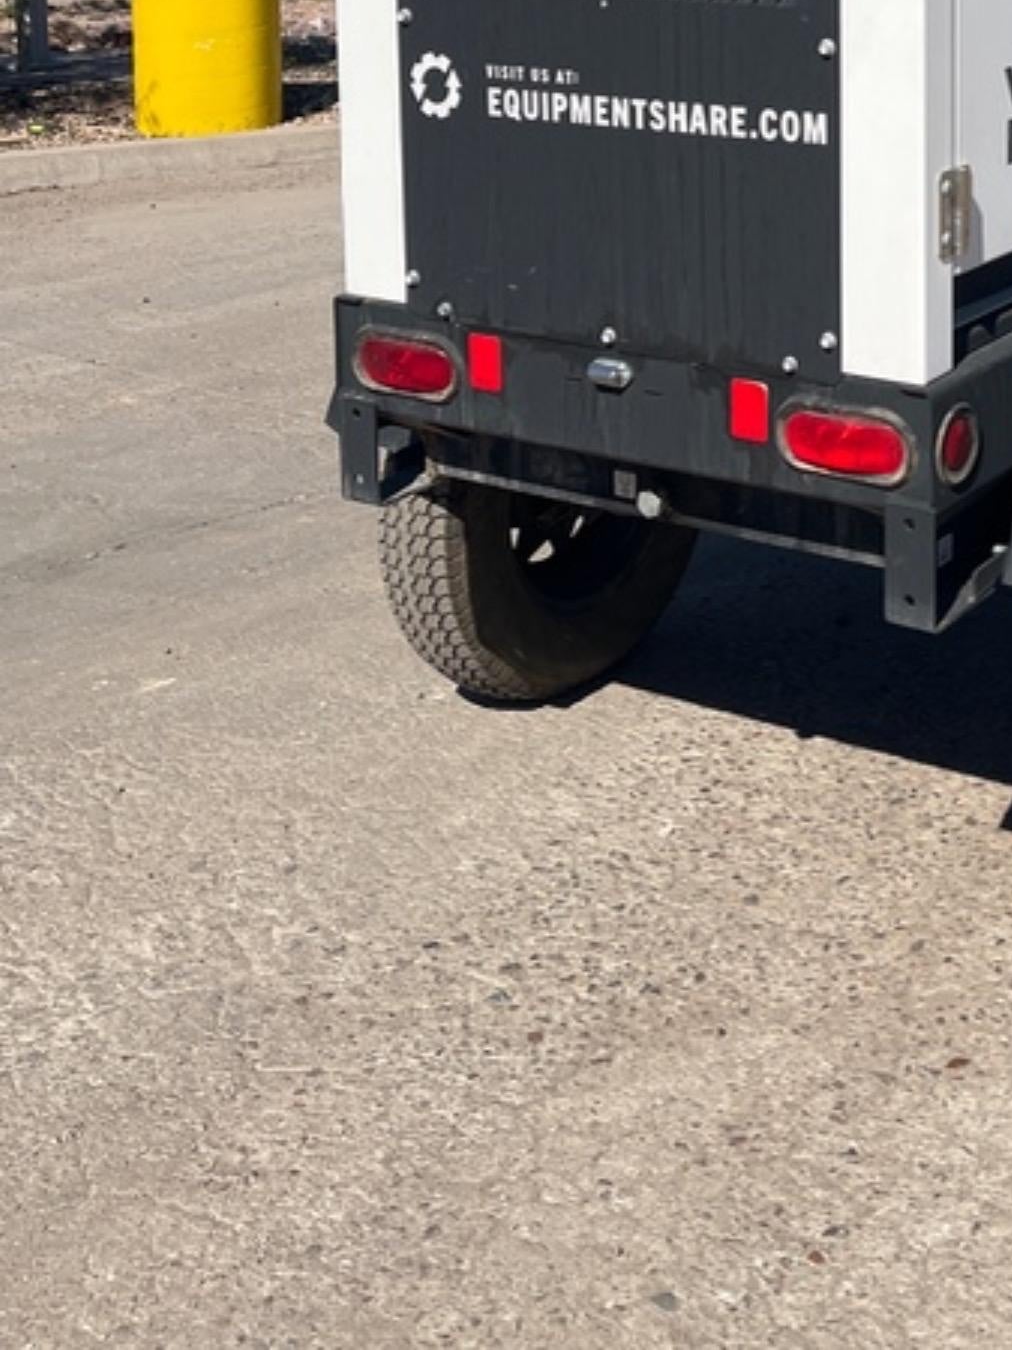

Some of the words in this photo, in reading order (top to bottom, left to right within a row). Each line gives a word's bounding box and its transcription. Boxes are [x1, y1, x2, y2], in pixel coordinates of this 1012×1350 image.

[485, 63, 525, 82] VISIT
[530, 67, 551, 84] US
[486, 86, 830, 146] EQUIPMENTSHARE.COM
